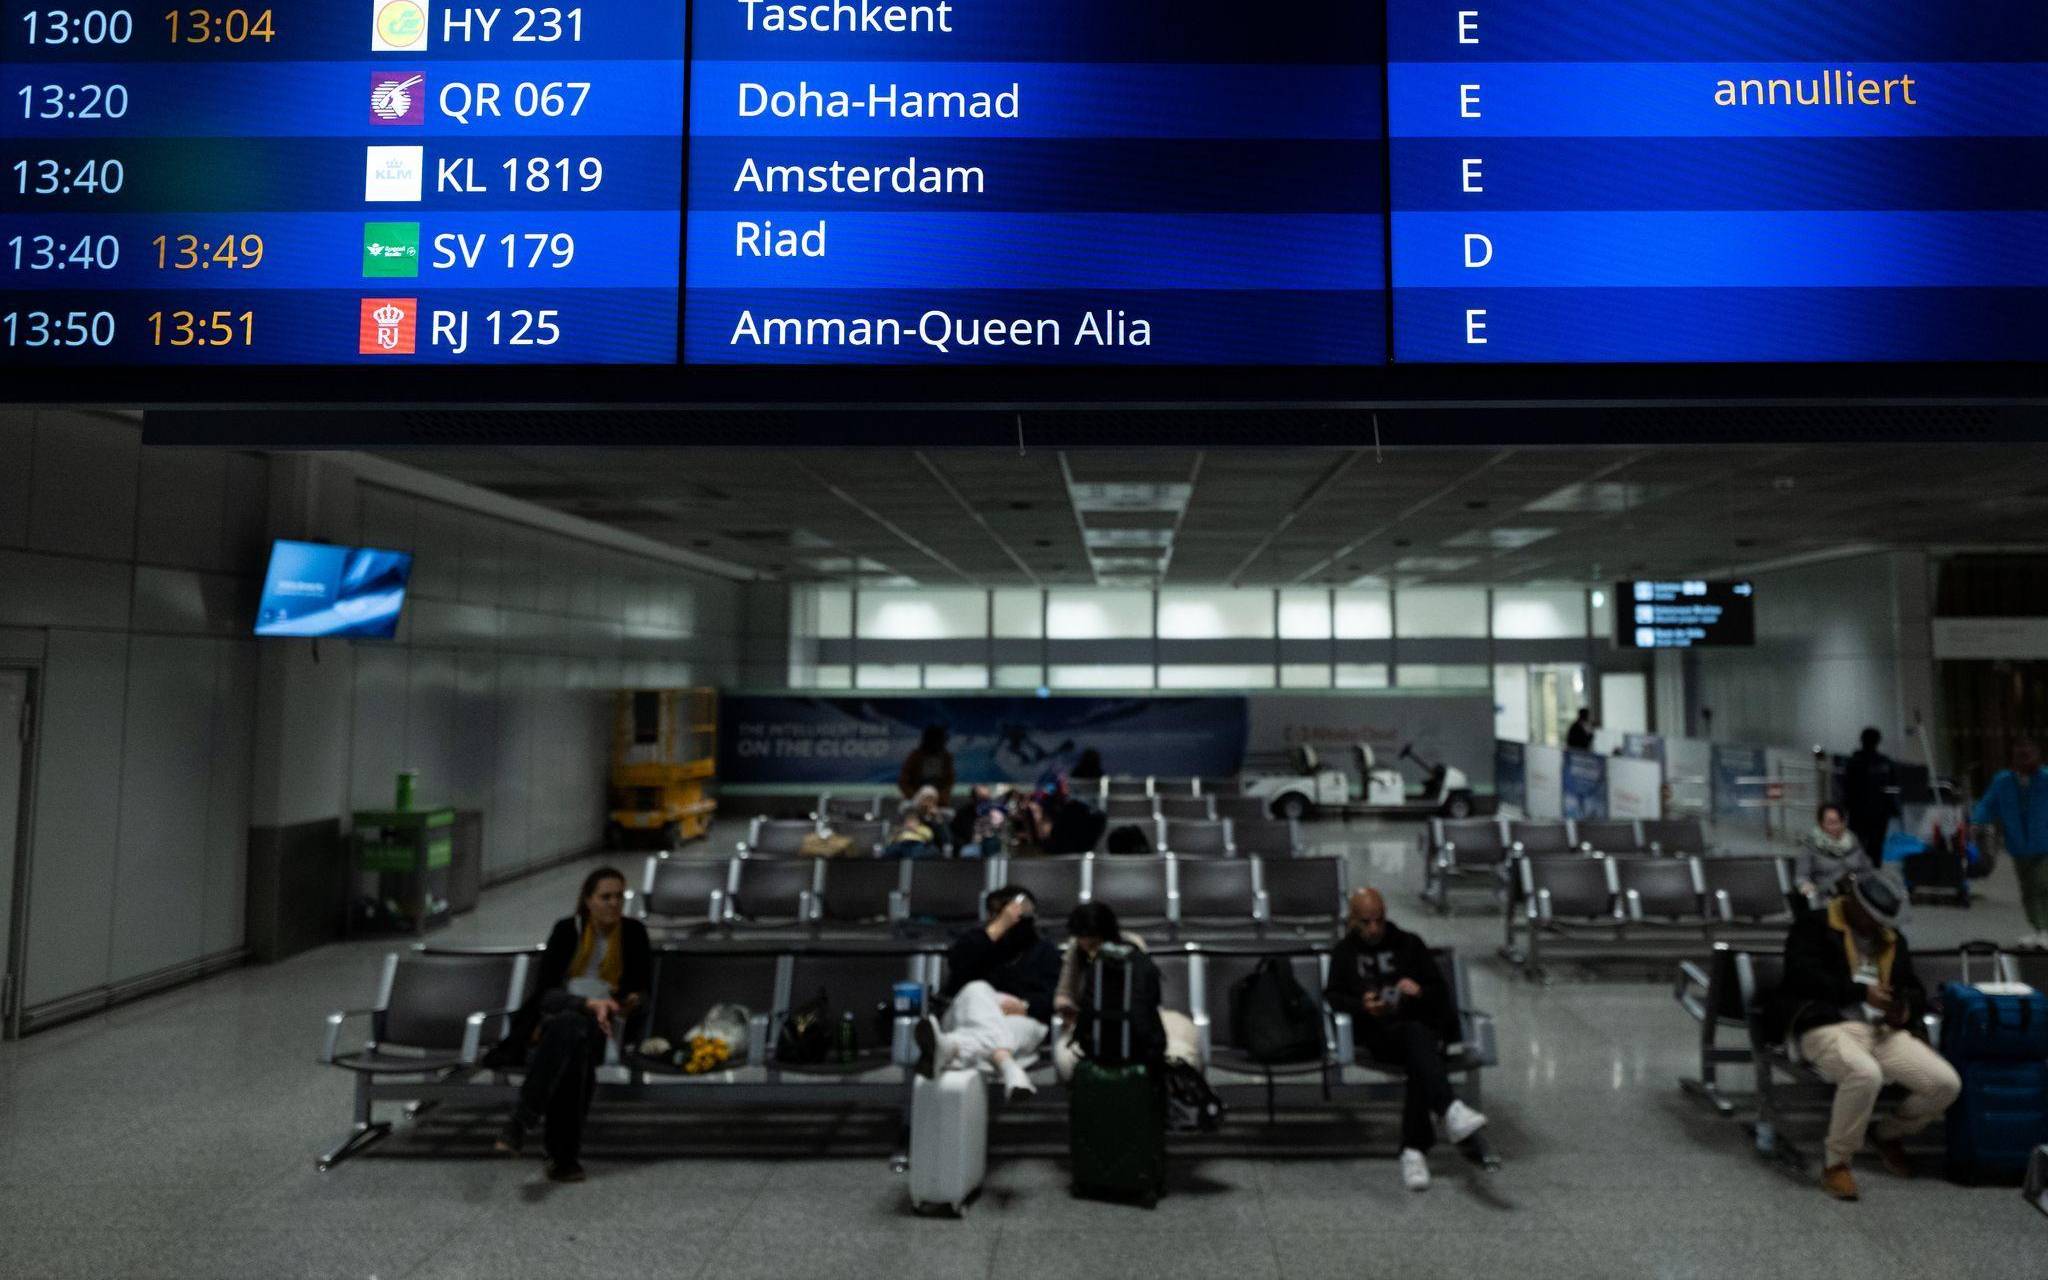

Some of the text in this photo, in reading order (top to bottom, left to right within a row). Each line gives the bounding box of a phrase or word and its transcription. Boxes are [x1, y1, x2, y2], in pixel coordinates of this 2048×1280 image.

[23, 7, 582, 44] 13:00 13:04 HY 231
[737, 0, 953, 33] Taschkent
[1458, 10, 1479, 44] E
[18, 81, 591, 125] 13:20 QR 067
[738, 81, 1019, 119] Doha-Hamad
[1460, 84, 1482, 118] E
[1714, 69, 1917, 106] annulliert
[13, 156, 603, 194] 13:40 KL 1819
[375, 169, 412, 180] KLM
[733, 156, 984, 193] Amsterdam
[1462, 158, 1484, 193] E
[8, 232, 575, 270] 13:40 13:49 SV 179
[736, 220, 826, 258] Riad
[1464, 233, 1493, 268] D
[3, 309, 560, 354] 13:50 13:51 RJ 125
[377, 327, 399, 350] RJ
[730, 309, 1151, 353] Amman-Queen Alia
[1466, 309, 1488, 344] E
